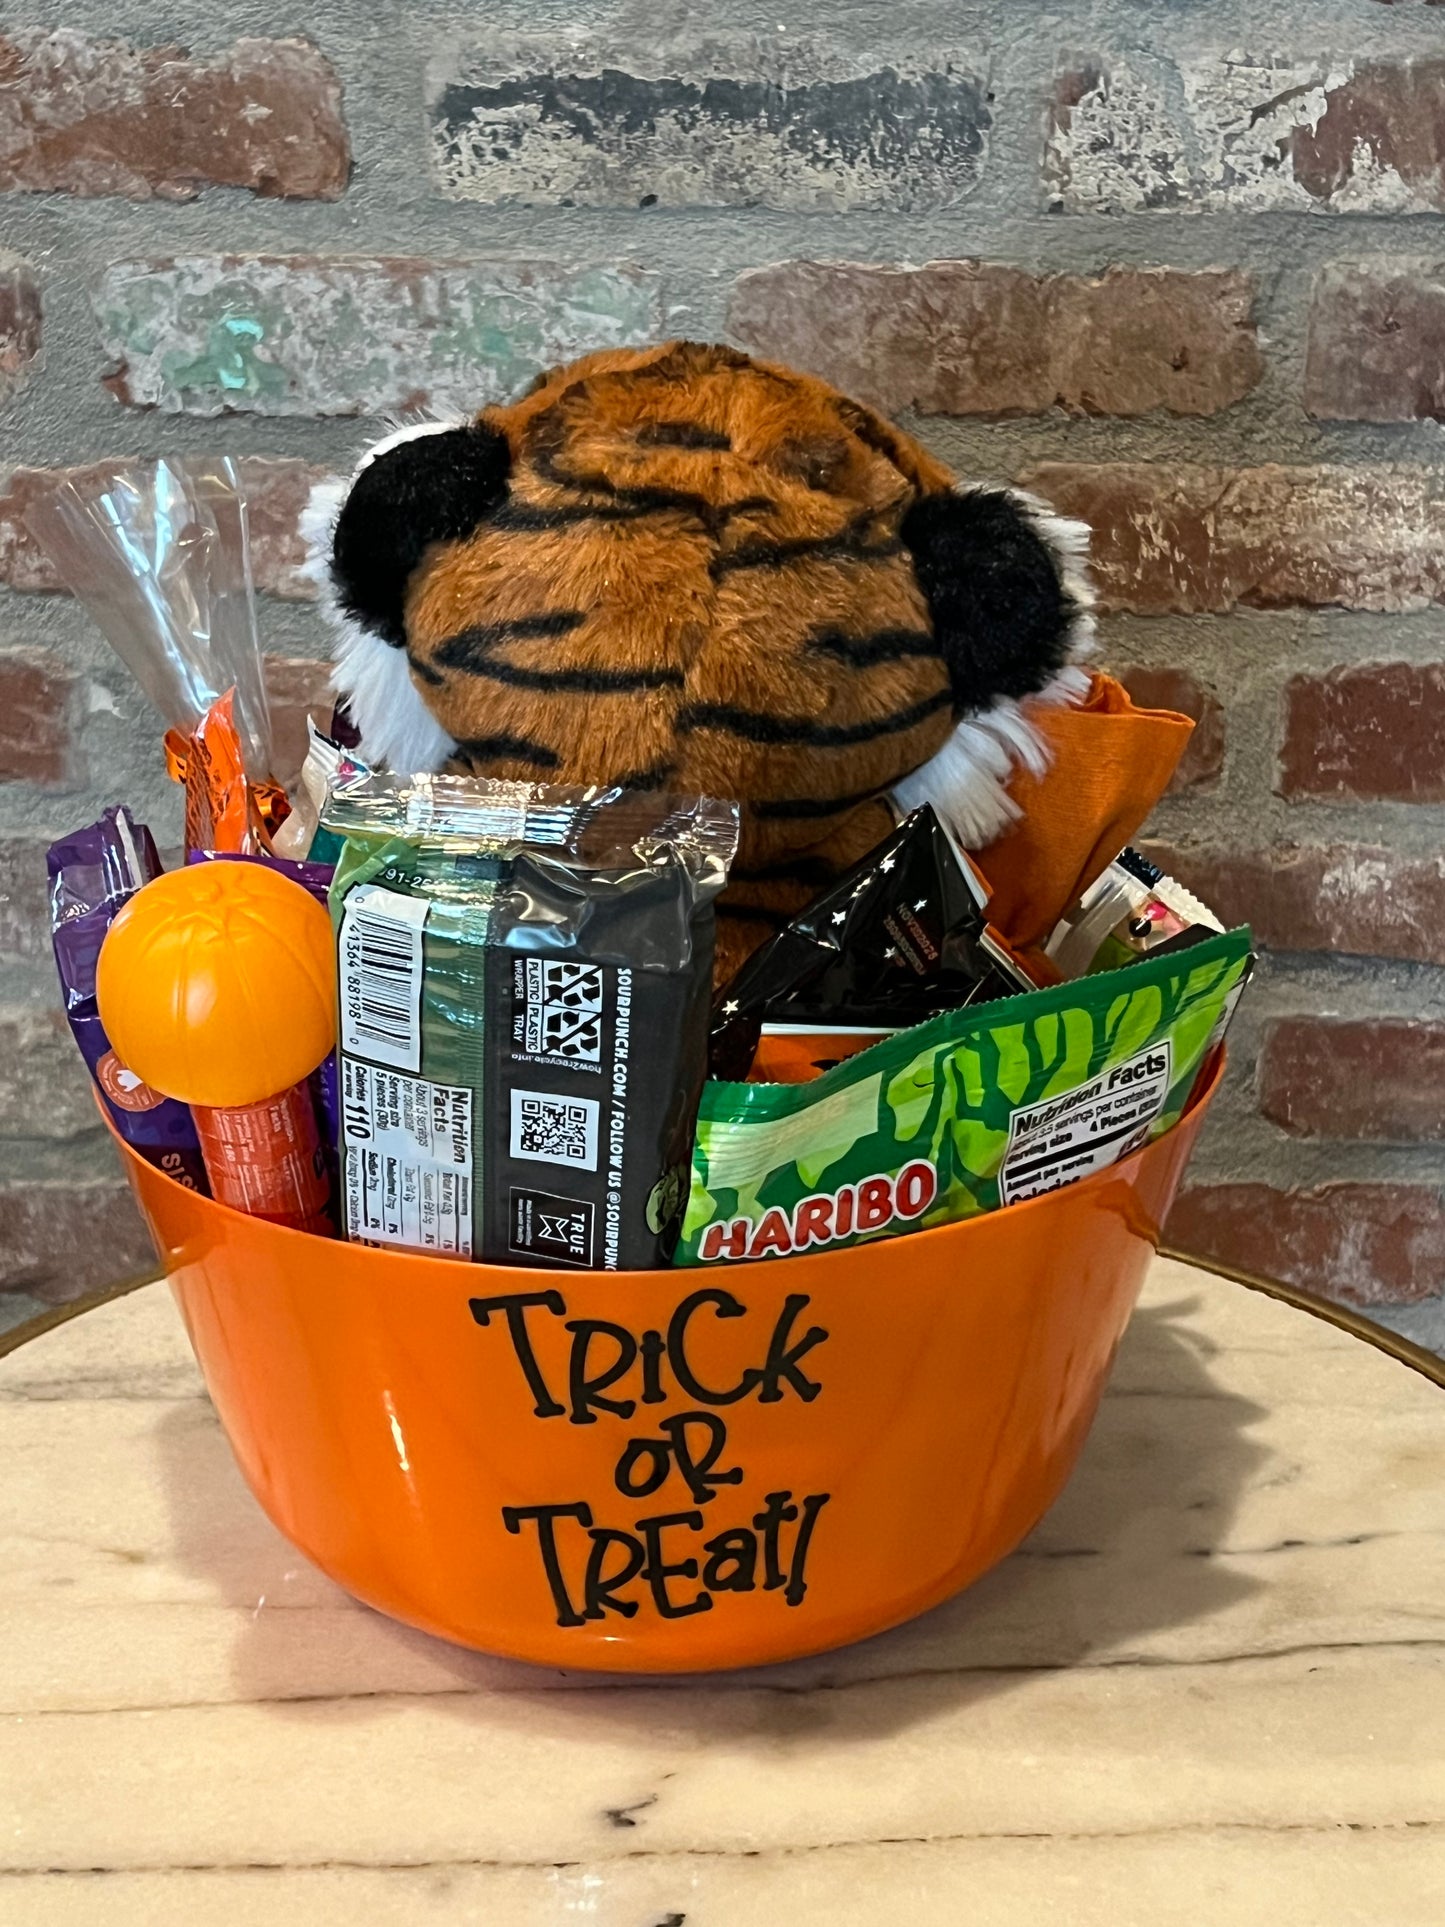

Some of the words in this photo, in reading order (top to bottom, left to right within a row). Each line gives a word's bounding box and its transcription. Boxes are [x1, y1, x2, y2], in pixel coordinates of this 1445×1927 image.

[347, 975, 361, 1020] 88198
[514, 959, 524, 999] WRAPPER
[528, 961, 540, 1001] PLASTIC
[513, 1014, 524, 1042] TRAY
[527, 1007, 539, 1051] PLASTIC
[612, 968, 632, 1097] SOURPUNCH.COM
[355, 1066, 367, 1101] Calories
[374, 1079, 388, 1107] pieces
[388, 1075, 400, 1109] Serving
[1015, 1082, 1102, 1137] Nutrition
[1108, 1055, 1165, 1090] Facts
[346, 1104, 370, 1139] 110
[434, 1088, 450, 1133] Facts
[451, 1091, 469, 1164] Nutrition
[1055, 1107, 1093, 1132] servings
[1096, 1101, 1112, 1118] per
[609, 1111, 625, 1169] FOLLOW
[1050, 1132, 1072, 1147] size
[608, 1171, 622, 1188] US
[1044, 1166, 1059, 1181] per
[698, 1159, 936, 1260] HARIBO
[570, 1213, 585, 1255] TRUE
